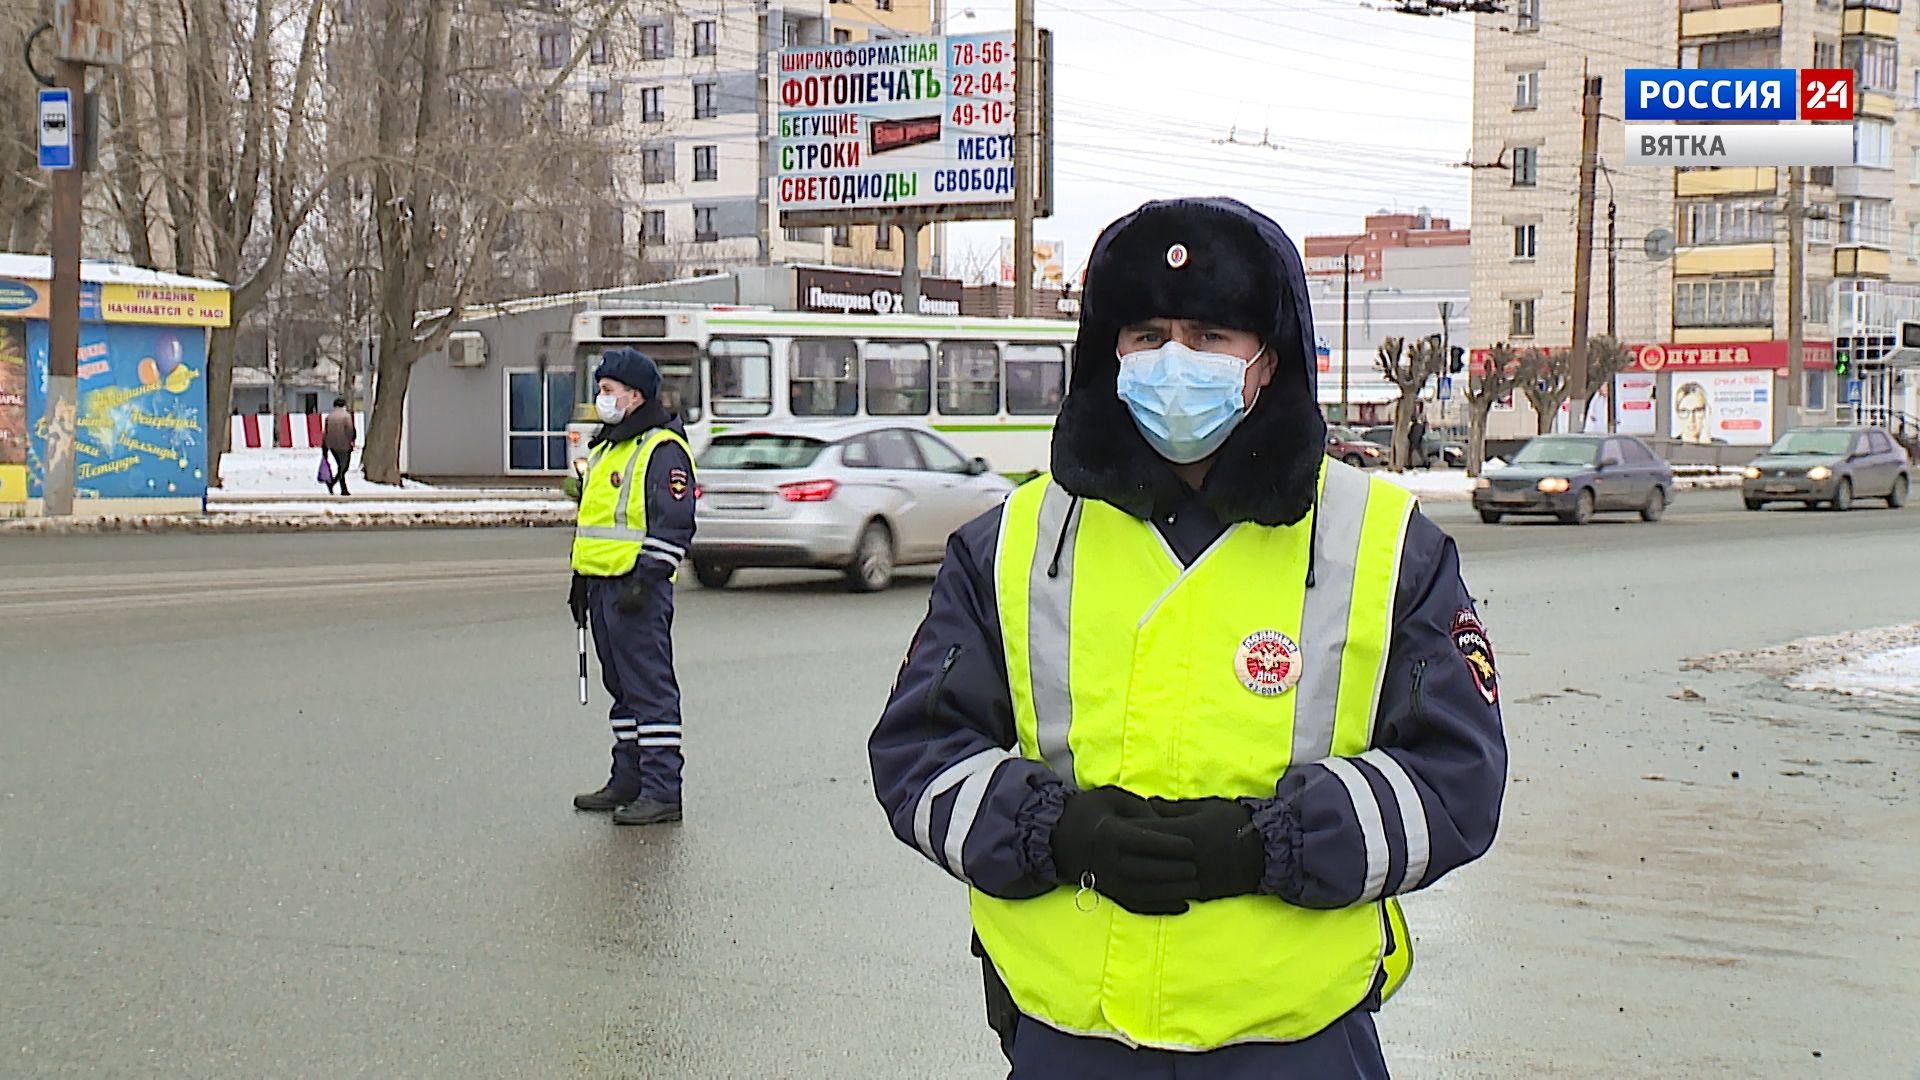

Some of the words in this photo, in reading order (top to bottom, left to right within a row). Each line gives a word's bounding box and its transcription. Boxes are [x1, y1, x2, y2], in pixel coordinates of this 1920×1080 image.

[781, 42, 938, 72] ШИРОКОФОРМАТНАЯ
[953, 41, 1016, 66] 78-56-
[781, 68, 941, 107] ФОТОПЕЧАТЬ
[953, 70, 1017, 96] 22-04-
[781, 113, 859, 139] БЕГУЩИЕ
[953, 101, 1017, 126] 49-10-
[781, 141, 860, 171] СТРОКИ
[781, 172, 918, 203] СВЕТОДИОДЫ
[137, 289, 196, 302] ПРАЗДНИК
[809, 286, 872, 314] Пекарня
[107, 303, 182, 317] НАЧИНАЕТСЯ
[187, 305, 195, 317] С
